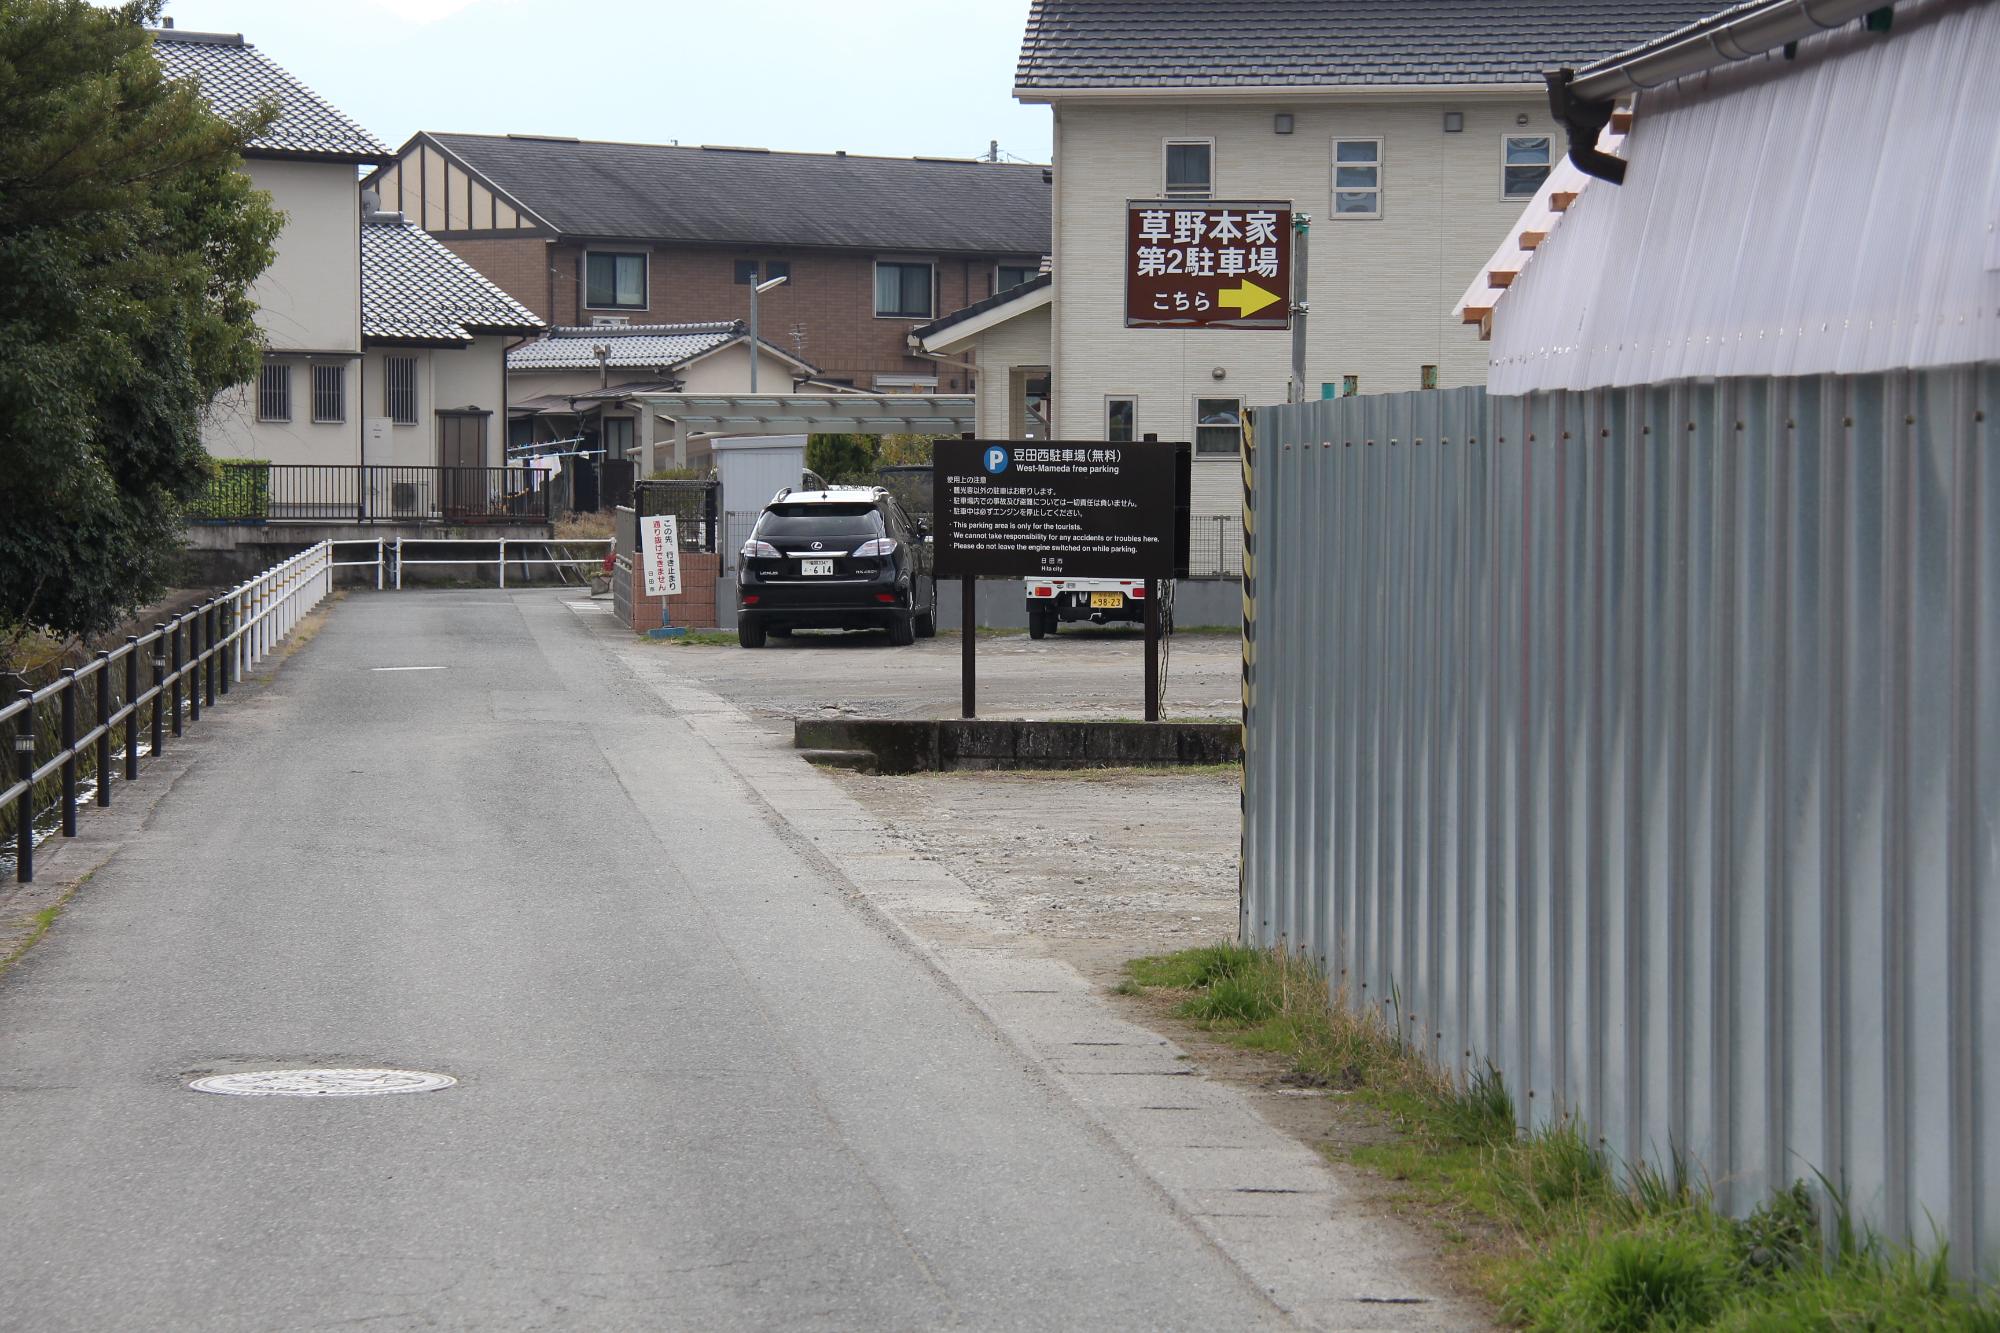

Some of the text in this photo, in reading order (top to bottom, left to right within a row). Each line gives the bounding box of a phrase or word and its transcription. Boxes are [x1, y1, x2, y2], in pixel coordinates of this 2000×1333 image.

[1138, 210, 1278, 245] 草野本家
[1136, 246, 1279, 278] 第2駐車場
[1153, 291, 1210, 311] こちら
[989, 450, 1004, 470] P
[1016, 464, 1120, 475] West-Mameda free parking
[946, 476, 987, 484] 使用上の注意
[968, 522, 993, 530] parking
[1016, 523, 1031, 531] only
[1055, 523, 1083, 531] tourists.
[1003, 533, 1047, 541] responsibility
[1048, 533, 1058, 541] for
[1072, 534, 1104, 542] accidents
[1142, 535, 1160, 543] here.
[997, 543, 1015, 551] leave
[1016, 543, 1027, 551] the
[1051, 544, 1081, 552] switched
[1110, 545, 1138, 554] parking.
